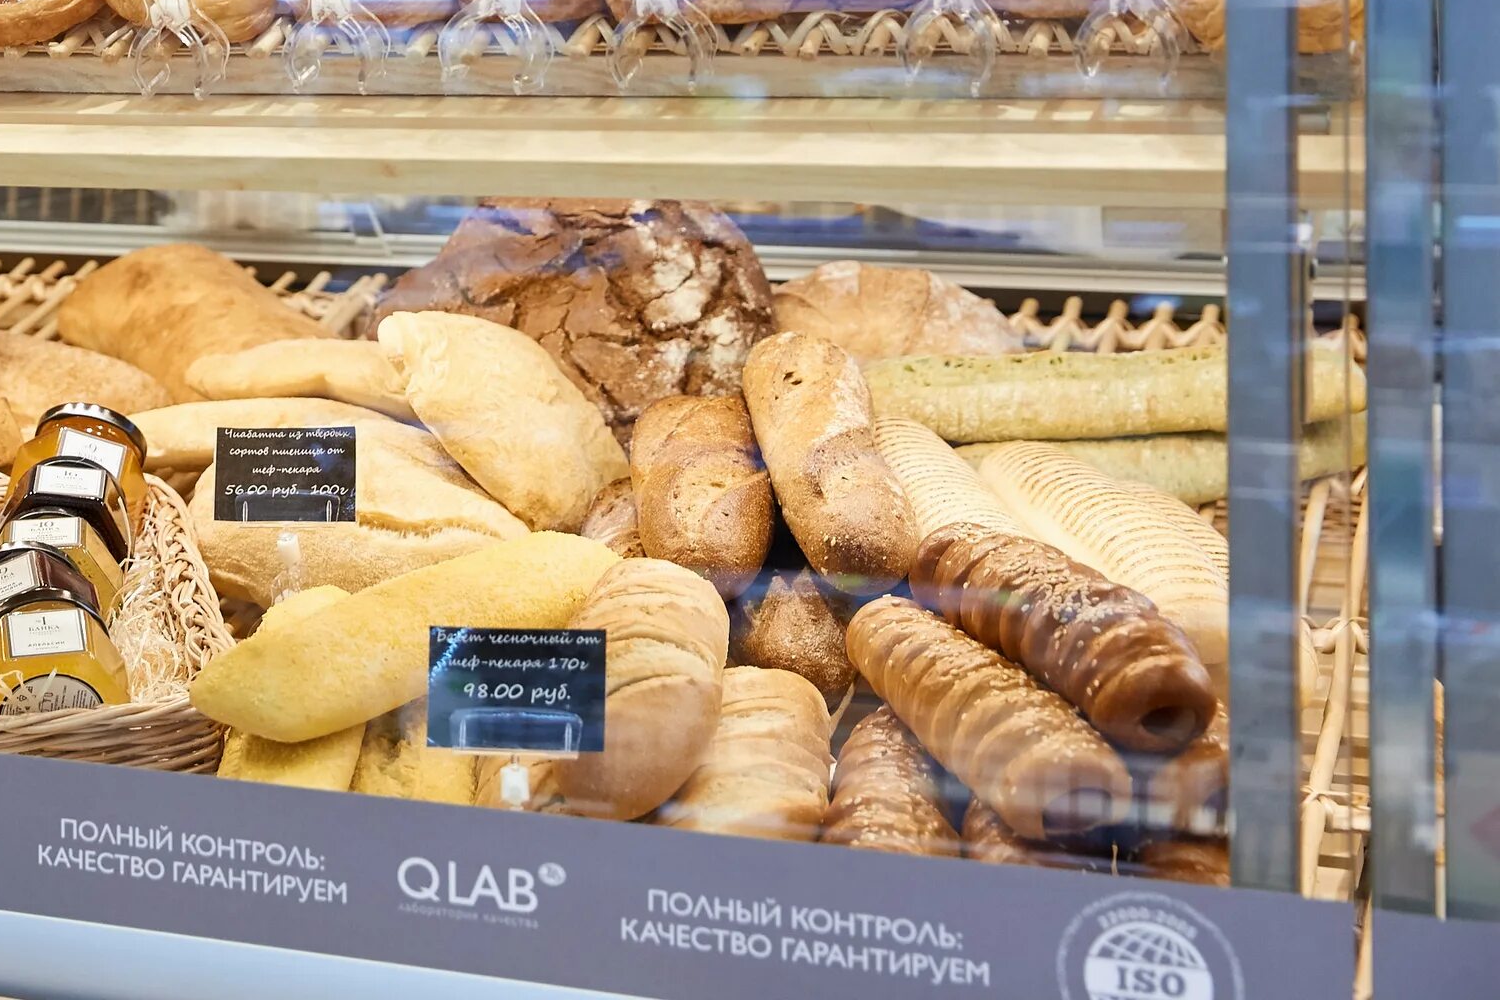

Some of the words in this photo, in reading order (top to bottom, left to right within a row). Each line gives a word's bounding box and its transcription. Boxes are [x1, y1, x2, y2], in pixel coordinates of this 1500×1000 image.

[225, 428, 288, 439] Чиабатта
[288, 430, 304, 440] из
[229, 447, 269, 458] сортов
[271, 448, 326, 458] пшеницы
[326, 447, 346, 456] от
[252, 464, 322, 477] шеф-пекаря
[271, 484, 300, 499] руб.
[310, 484, 349, 496] 100г
[488, 631, 574, 645] чесночный
[575, 637, 601, 645] от
[448, 654, 545, 672] шеф-пекаря
[548, 657, 589, 671] 170г
[463, 682, 524, 700] 98.00
[530, 684, 571, 705] руб.
[60, 817, 173, 852] ПОЛНЫЙ
[181, 832, 326, 871] КОНТРОЛЬ:
[37, 844, 165, 881] КАЧЕСТВО
[172, 860, 348, 904] ГАРАНТИРУЕМ
[397, 857, 539, 913] QLAB
[647, 888, 782, 928] ПОЛНЫЙ
[791, 905, 964, 951] КОНТРОЛЬ:
[620, 917, 772, 959] КАЧЕСТВО
[781, 937, 990, 987] ГАРАНТИРУЕМ
[1116, 966, 1186, 997] ISO
